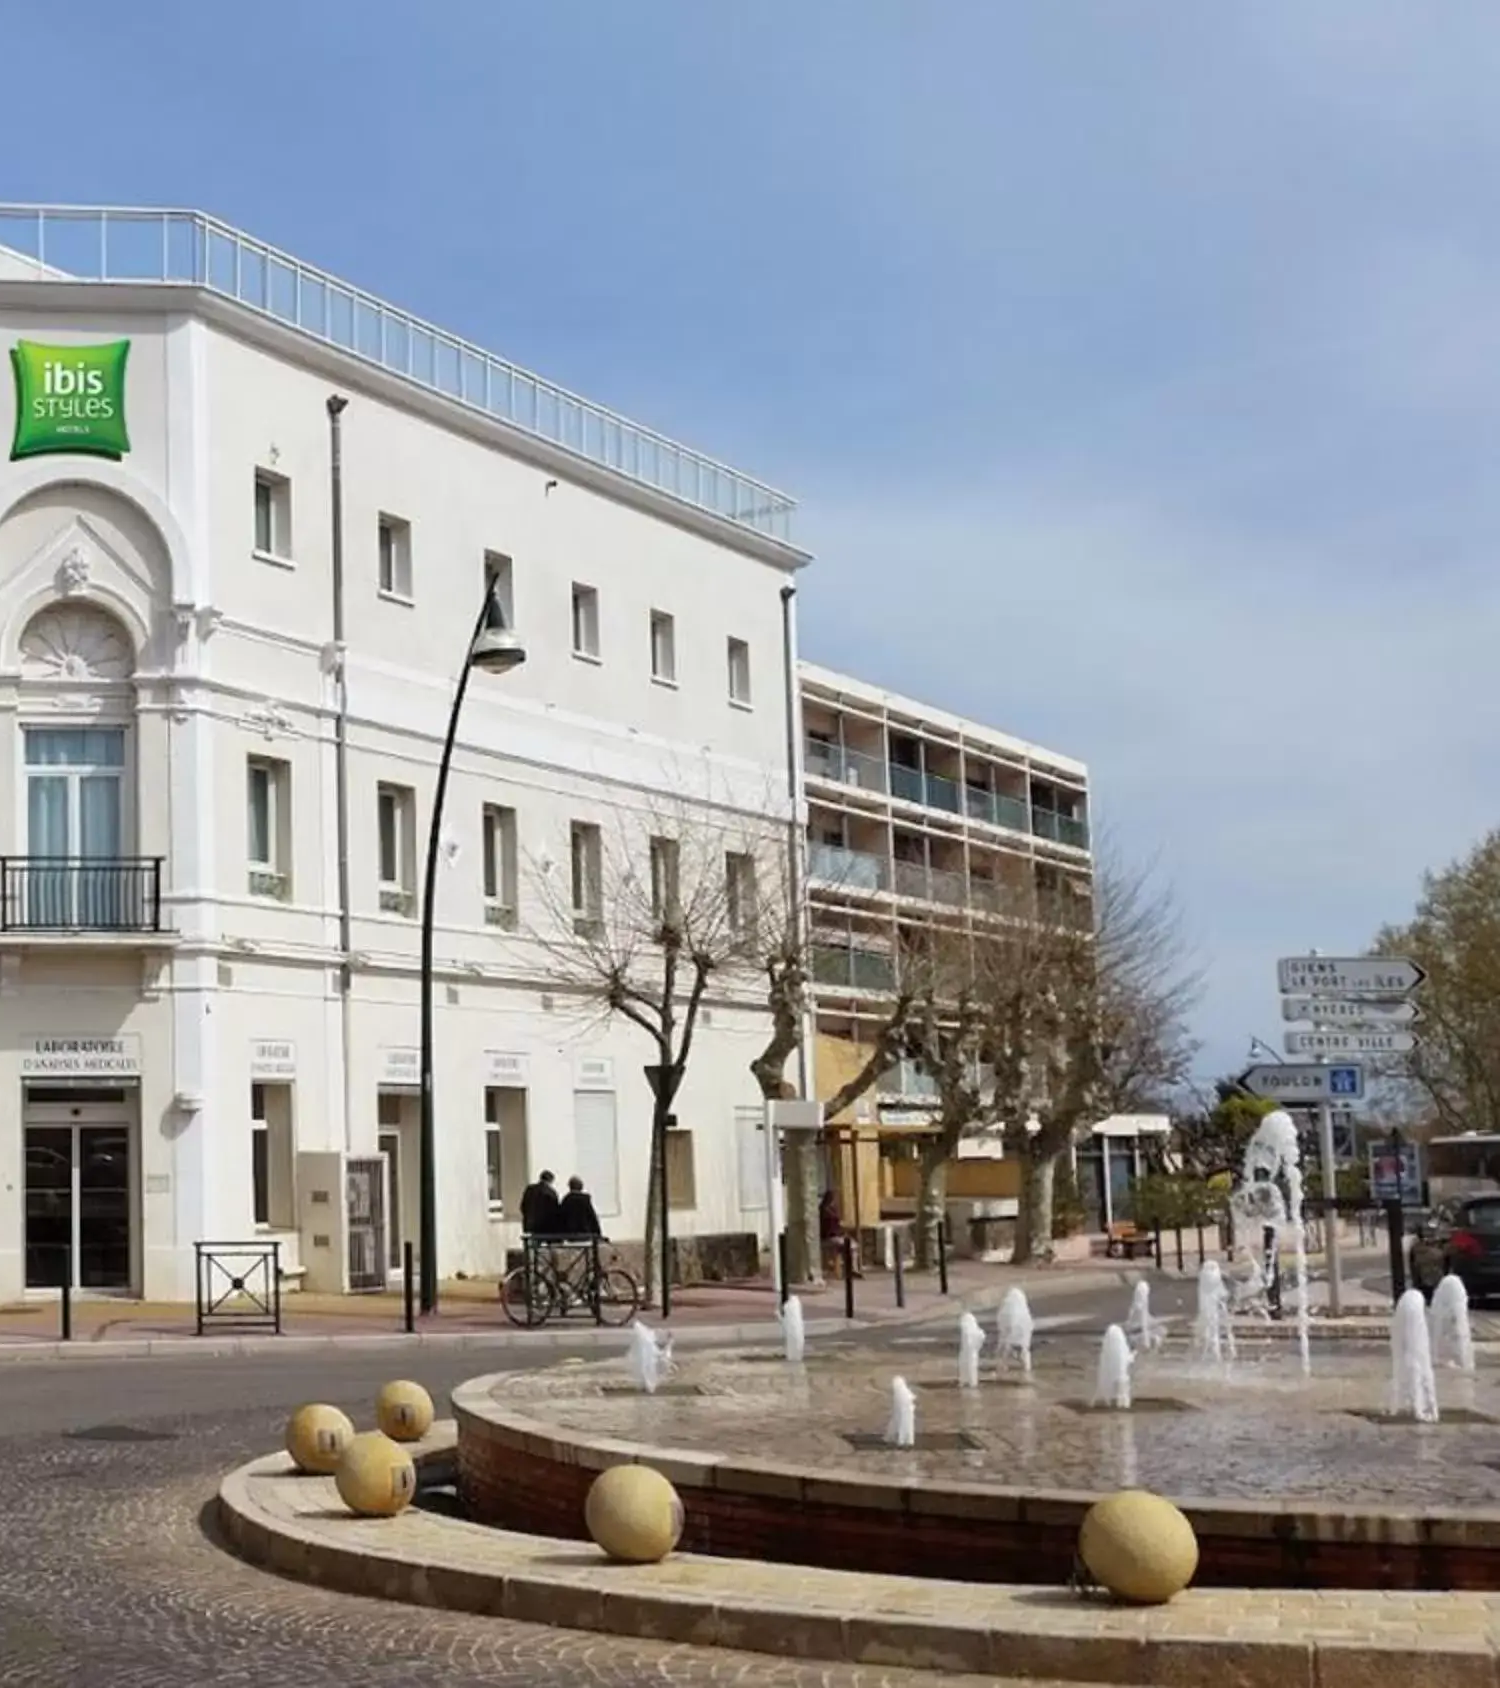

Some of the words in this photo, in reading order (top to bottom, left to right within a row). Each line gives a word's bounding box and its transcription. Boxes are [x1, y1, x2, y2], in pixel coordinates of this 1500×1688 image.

[43, 361, 104, 395] ibis
[1290, 962, 1337, 974] GIENS
[35, 1040, 124, 1055] LABORATOIRE
[1300, 1036, 1349, 1048] CENTRE
[1357, 1036, 1393, 1048] VILLE
[1260, 1075, 1324, 1088] TOULON
